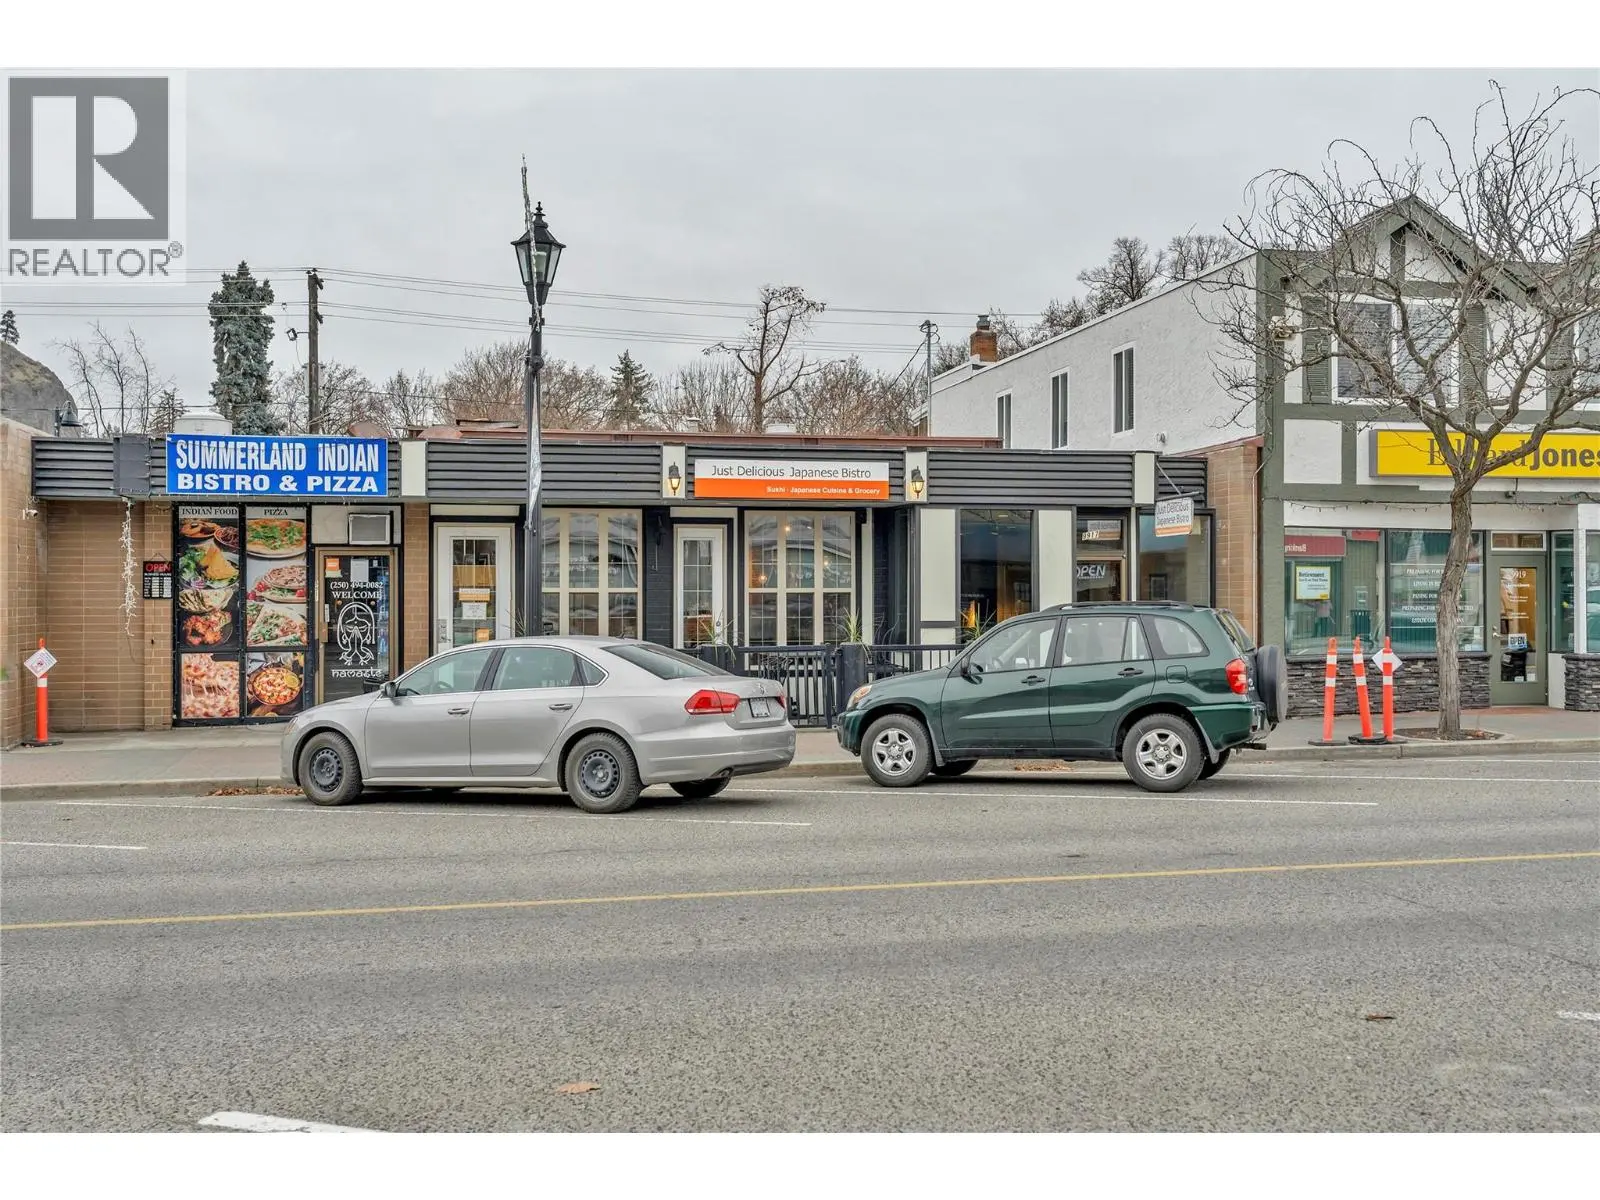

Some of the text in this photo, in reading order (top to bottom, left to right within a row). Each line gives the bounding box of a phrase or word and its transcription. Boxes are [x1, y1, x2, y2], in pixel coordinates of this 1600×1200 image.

[175, 439, 379, 472] SUMMERLAND INDIAN
[712, 465, 871, 480] Just Delicious Japanese Bistro
[177, 473, 378, 492] BISTRO & PIZZA
[145, 563, 170, 572] OPEN
[332, 591, 383, 599] WELCOME
